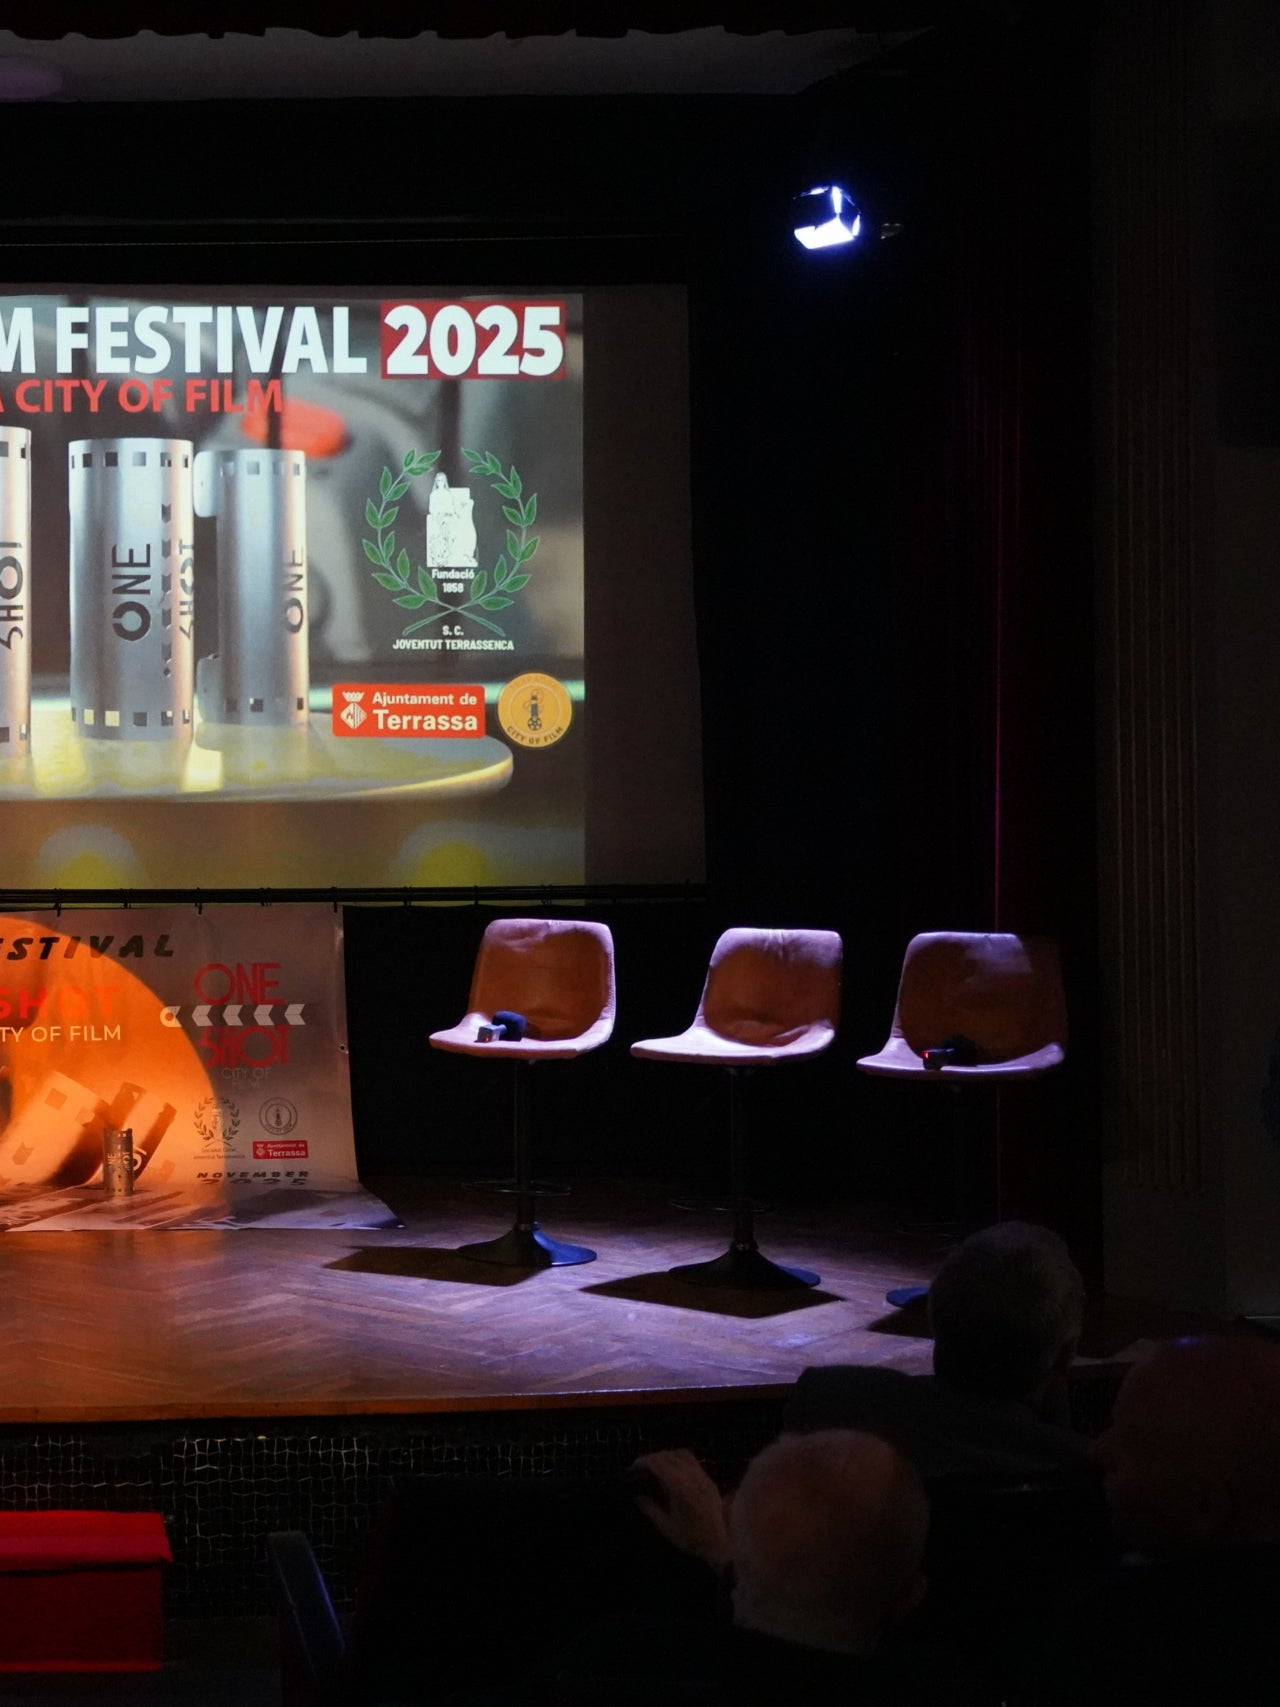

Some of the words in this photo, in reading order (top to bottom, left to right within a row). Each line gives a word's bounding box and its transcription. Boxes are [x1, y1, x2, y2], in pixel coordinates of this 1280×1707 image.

[55, 305, 367, 374] FESTIVAL
[383, 304, 564, 376] 2025
[15, 379, 107, 413] CITY
[118, 379, 172, 413] OF
[185, 379, 283, 413] FILM
[431, 568, 476, 580] Fundació
[111, 543, 151, 641] ONE
[281, 547, 303, 635] ONE
[442, 625, 452, 636] S.
[453, 625, 464, 636] C.
[392, 639, 443, 650] JOVENTUT
[444, 639, 515, 650] TERRASSENCA
[372, 691, 454, 708] Ajuntament
[459, 693, 477, 705] de
[372, 710, 478, 731] Terrassa
[507, 725, 526, 742] CITY
[543, 725, 563, 743] FILM
[193, 962, 285, 1005] ONE
[30, 1025, 62, 1043] OF
[69, 1024, 122, 1042] FILM
[198, 1025, 292, 1068] SHOT
[267, 1149, 306, 1157] Terrassa
[196, 1171, 310, 1179] NOVEMBER
